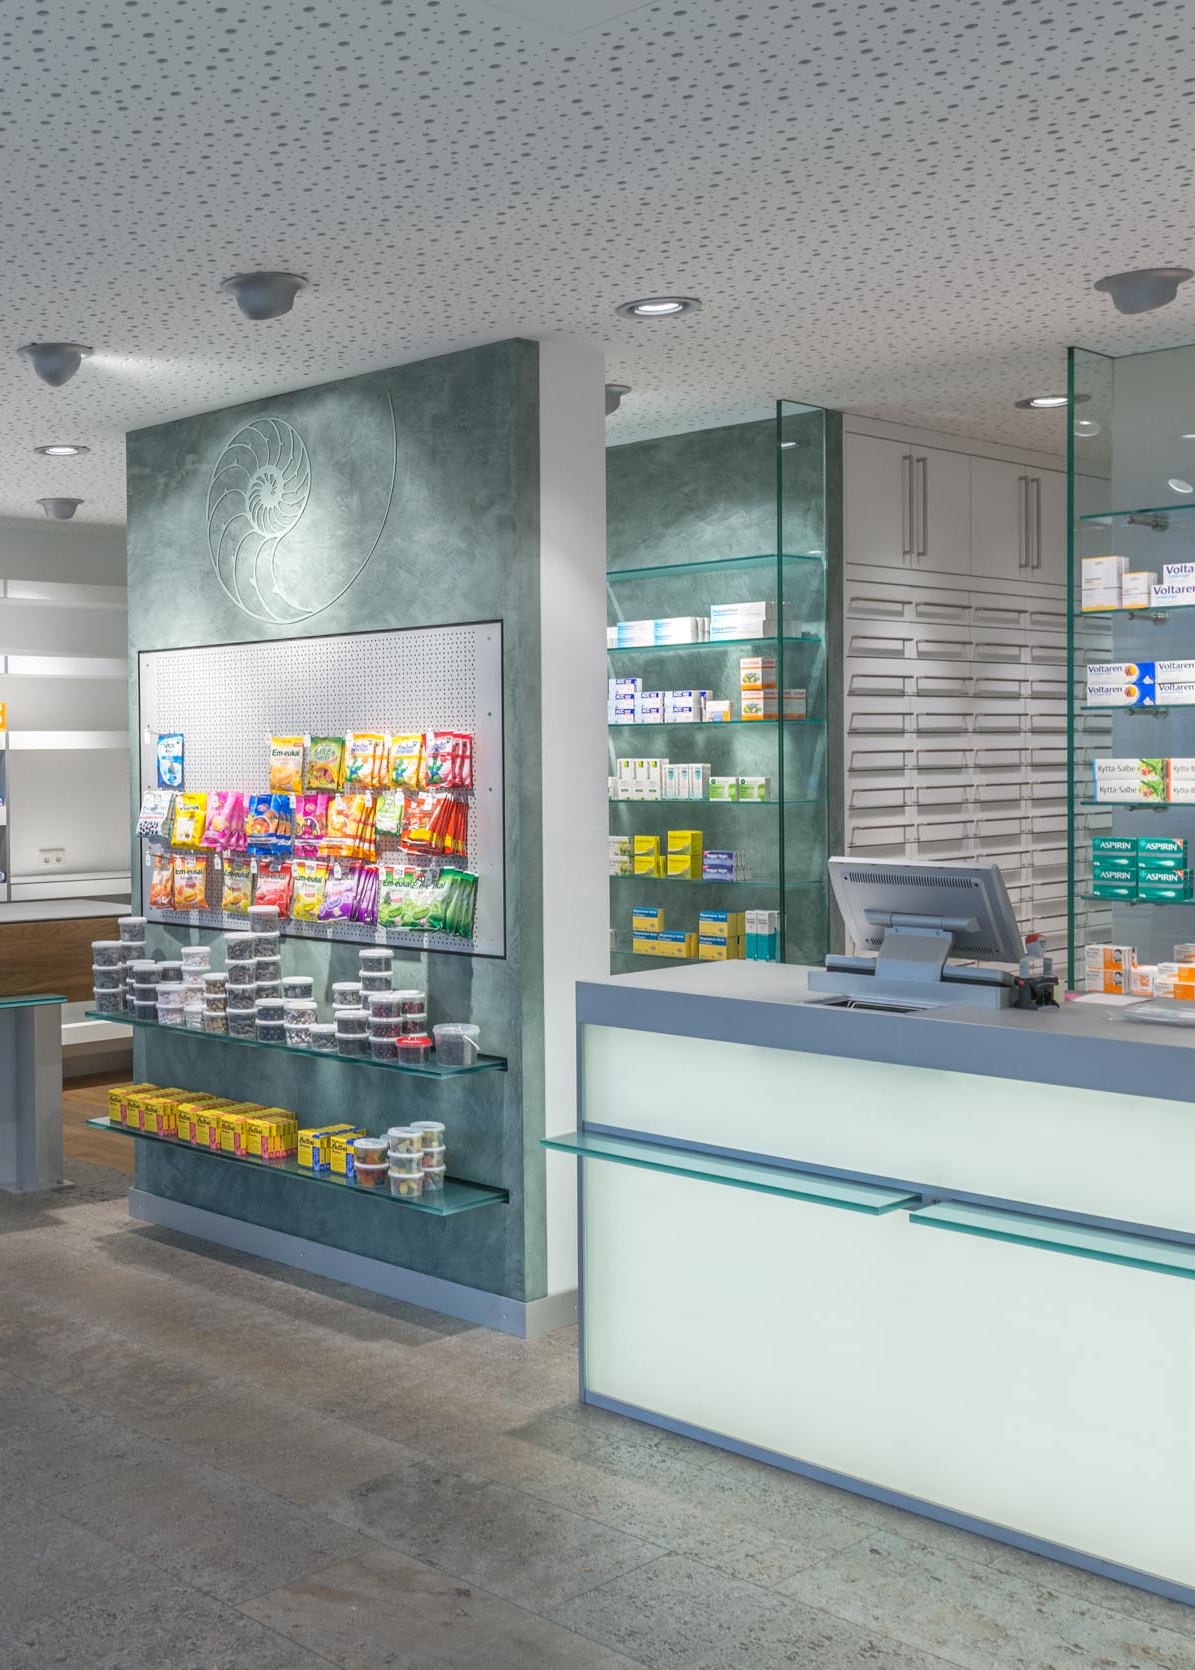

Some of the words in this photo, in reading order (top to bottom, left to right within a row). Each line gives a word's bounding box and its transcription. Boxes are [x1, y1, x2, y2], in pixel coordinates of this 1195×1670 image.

[1165, 564, 1194, 574] Volta
[1088, 665, 1123, 673] Voltaren
[1158, 662, 1195, 670] Voltaren
[1088, 686, 1123, 694] Voltaren
[1158, 683, 1195, 691] Voltaren
[1097, 765, 1136, 773] Kytta-Salbe
[1099, 786, 1137, 794] Kytta-Salbe
[1099, 841, 1131, 849] ASPIRIN
[1145, 842, 1177, 851] ASPIRIN
[1100, 871, 1131, 880] ASPIRIN
[1145, 873, 1178, 882] ASPIRIN
